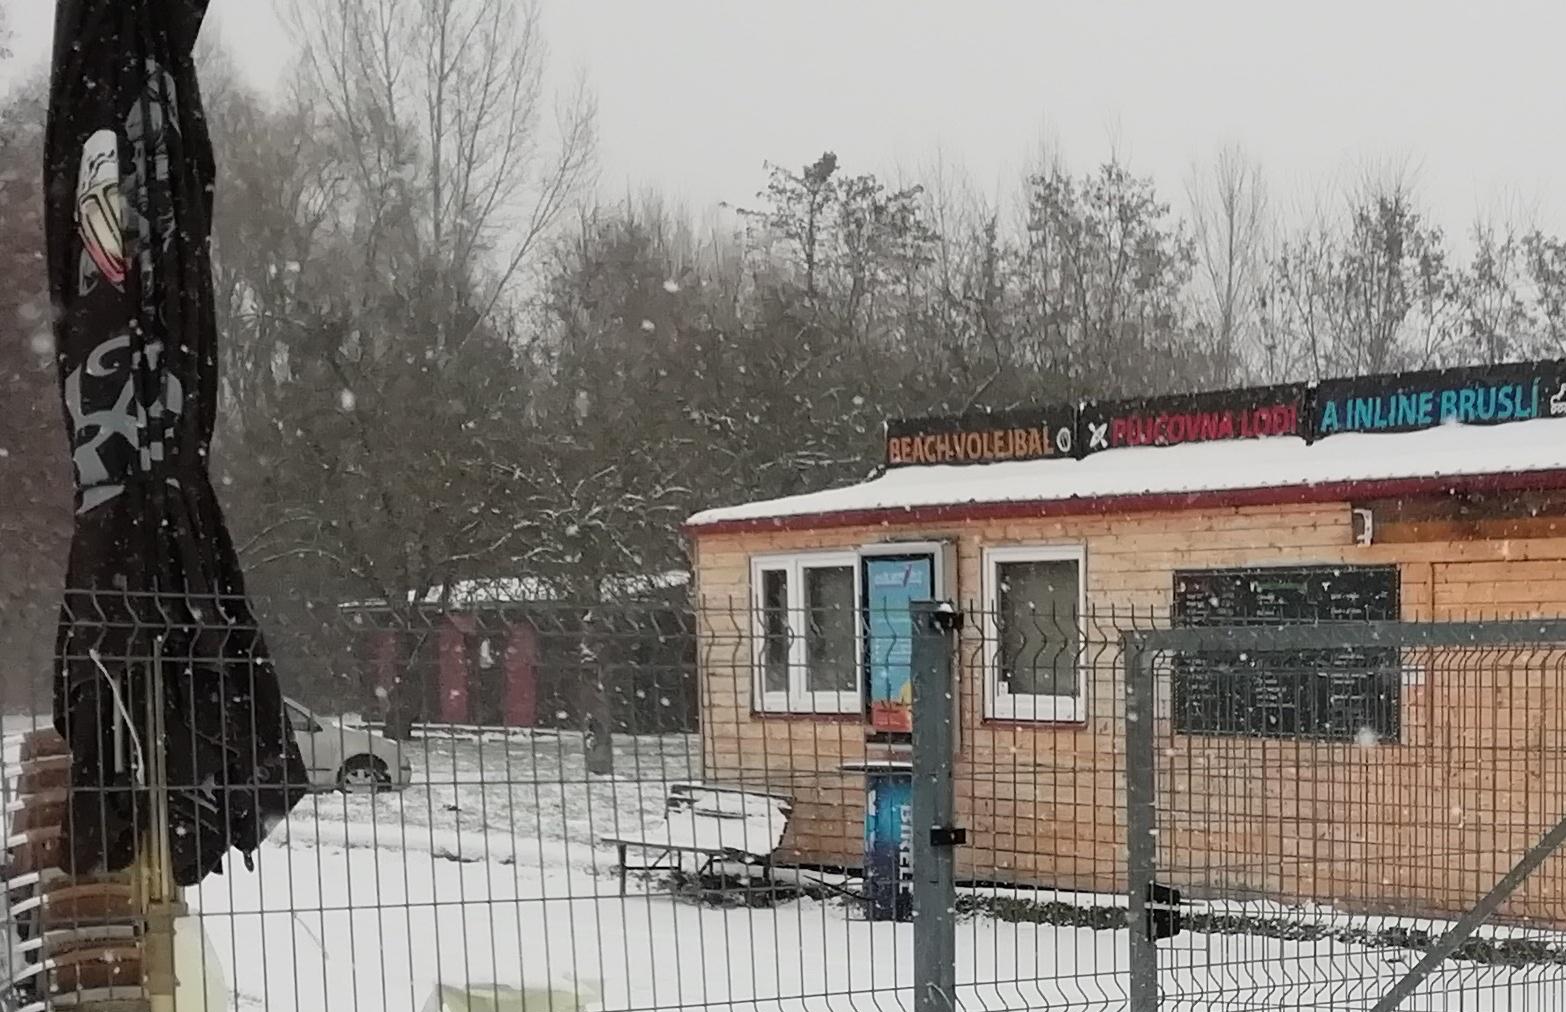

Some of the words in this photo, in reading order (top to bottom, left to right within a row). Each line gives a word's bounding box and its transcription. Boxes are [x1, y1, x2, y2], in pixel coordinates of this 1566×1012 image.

[1320, 399, 1338, 432] A
[1346, 391, 1433, 430] INLINE
[1440, 377, 1542, 424] BRUSLÍ
